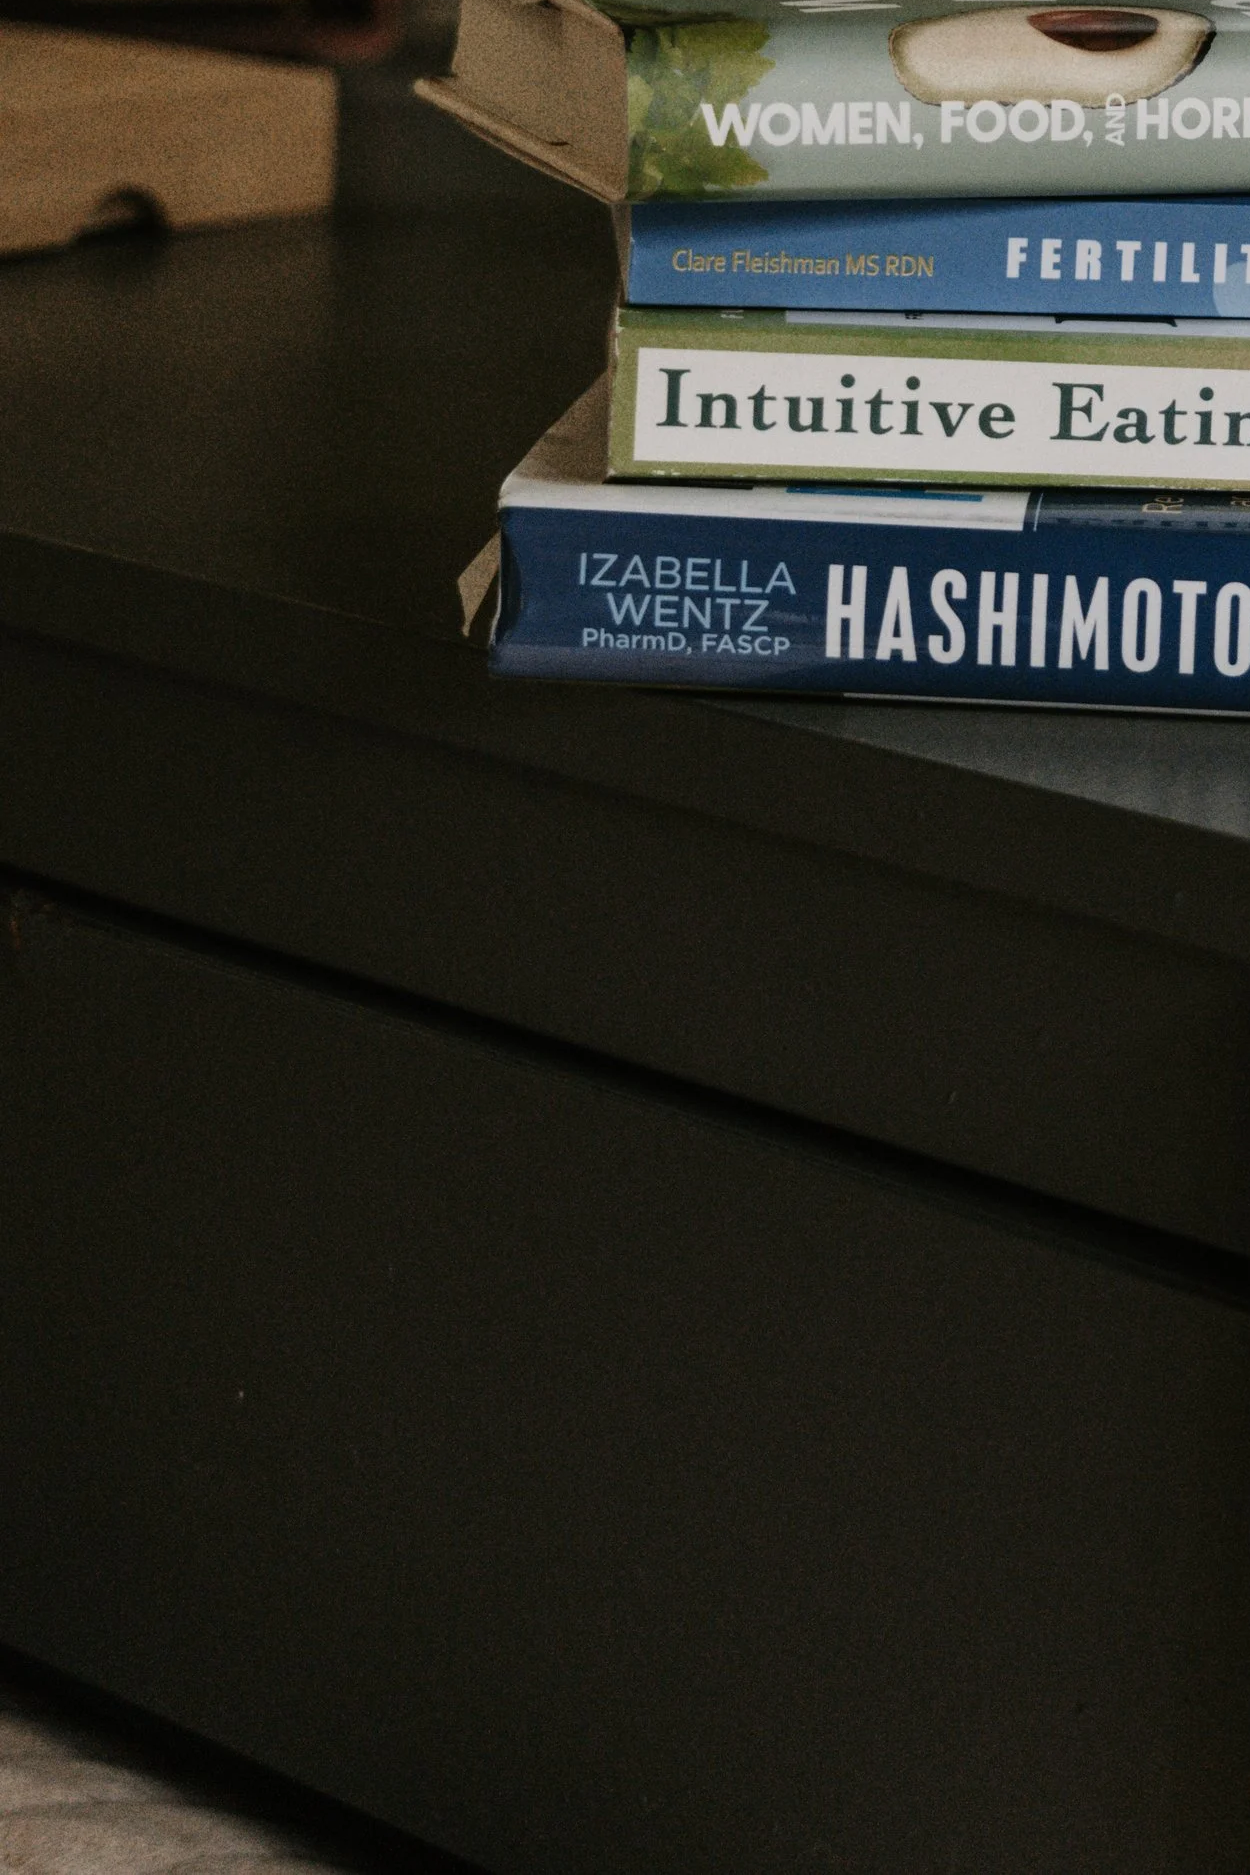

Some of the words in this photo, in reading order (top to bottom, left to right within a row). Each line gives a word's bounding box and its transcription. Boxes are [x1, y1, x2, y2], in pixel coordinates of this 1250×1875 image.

[700, 101, 924, 150] WOMEN,
[941, 99, 1093, 147] FOOD,
[1105, 92, 1126, 146] AND
[672, 249, 725, 272] Clare
[732, 249, 839, 274] Fleishman
[845, 254, 880, 276] MS
[885, 255, 934, 277] RDN
[656, 368, 1016, 439] Intuitive
[579, 552, 797, 595] IZABELLA
[606, 592, 770, 632] WENTZ
[582, 628, 693, 655] PharmD,
[702, 633, 790, 656] FASCP
